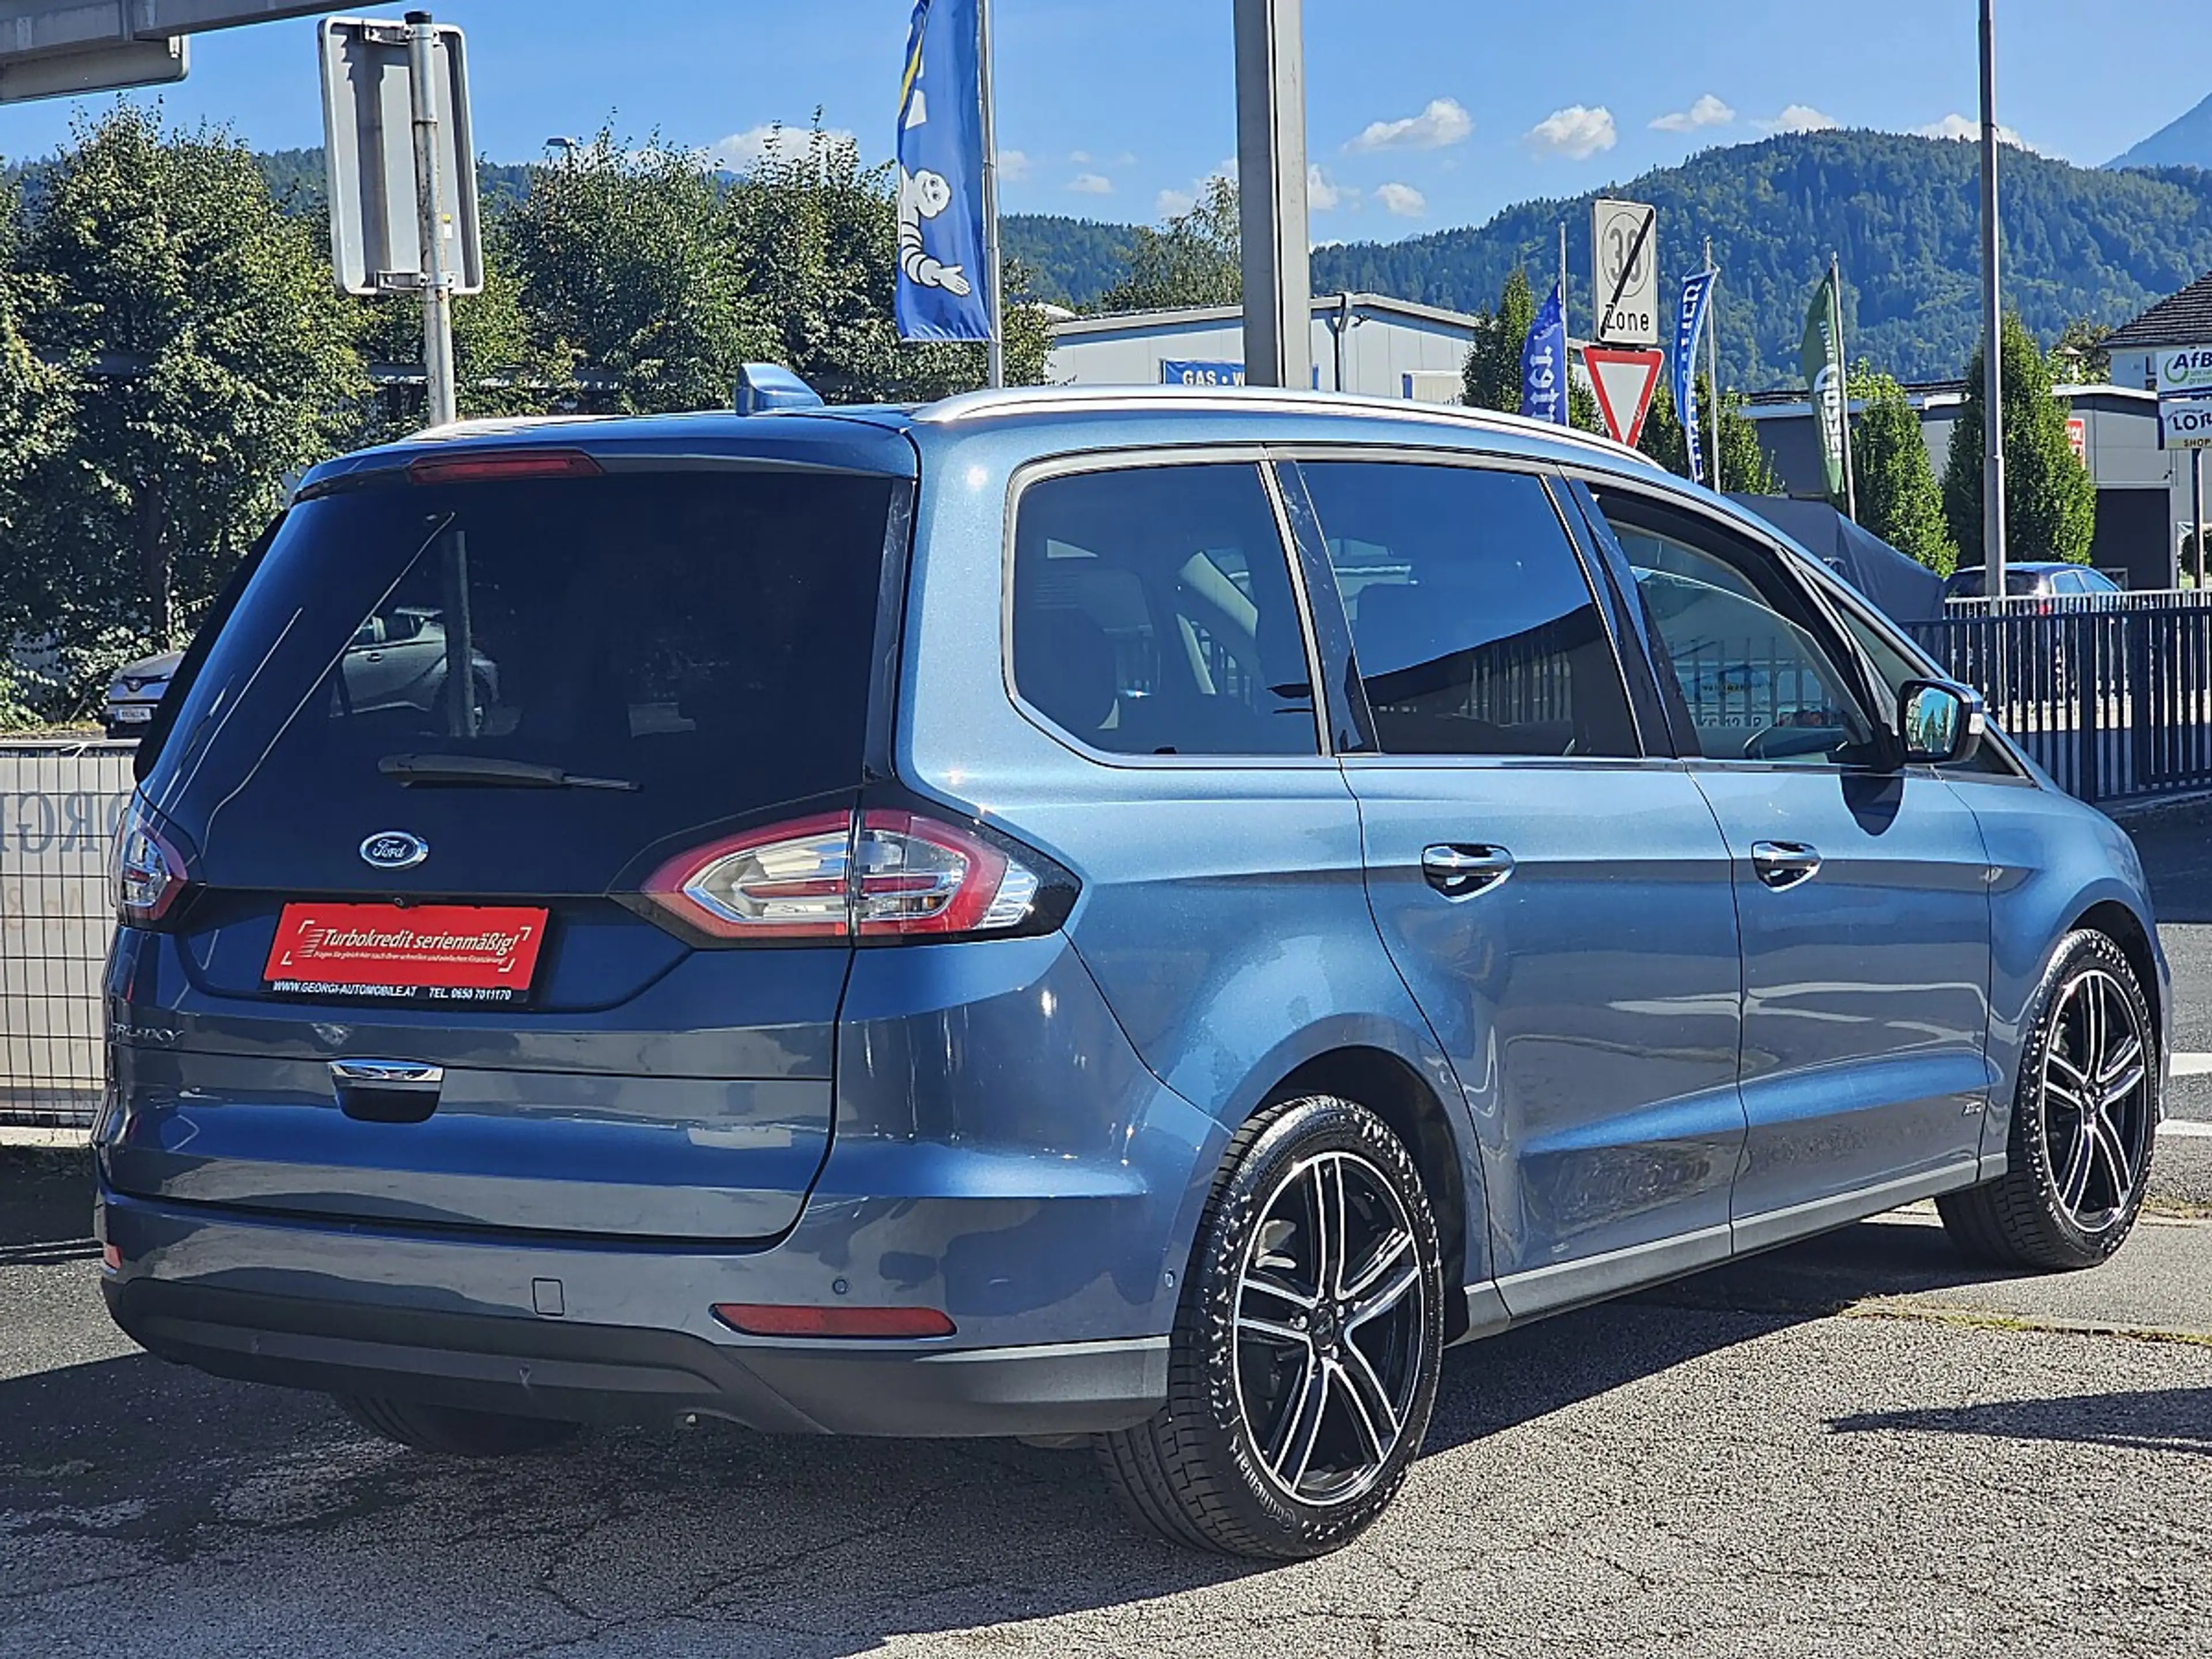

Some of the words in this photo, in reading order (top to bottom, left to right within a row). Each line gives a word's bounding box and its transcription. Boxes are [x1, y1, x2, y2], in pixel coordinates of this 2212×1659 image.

[1605, 304, 1649, 331] Zone
[2172, 351, 2212, 369] AfB
[1183, 370, 1217, 387] GAS
[372, 839, 407, 858] Ford
[323, 929, 414, 948] Turbokredit
[413, 931, 520, 956] serienmäßig!
[273, 980, 417, 997] WWW.GEORGI-AUTOMOBILE.AT
[429, 987, 449, 999] TEL.
[451, 988, 473, 1000] 0650
[475, 988, 512, 1000] 7011170
